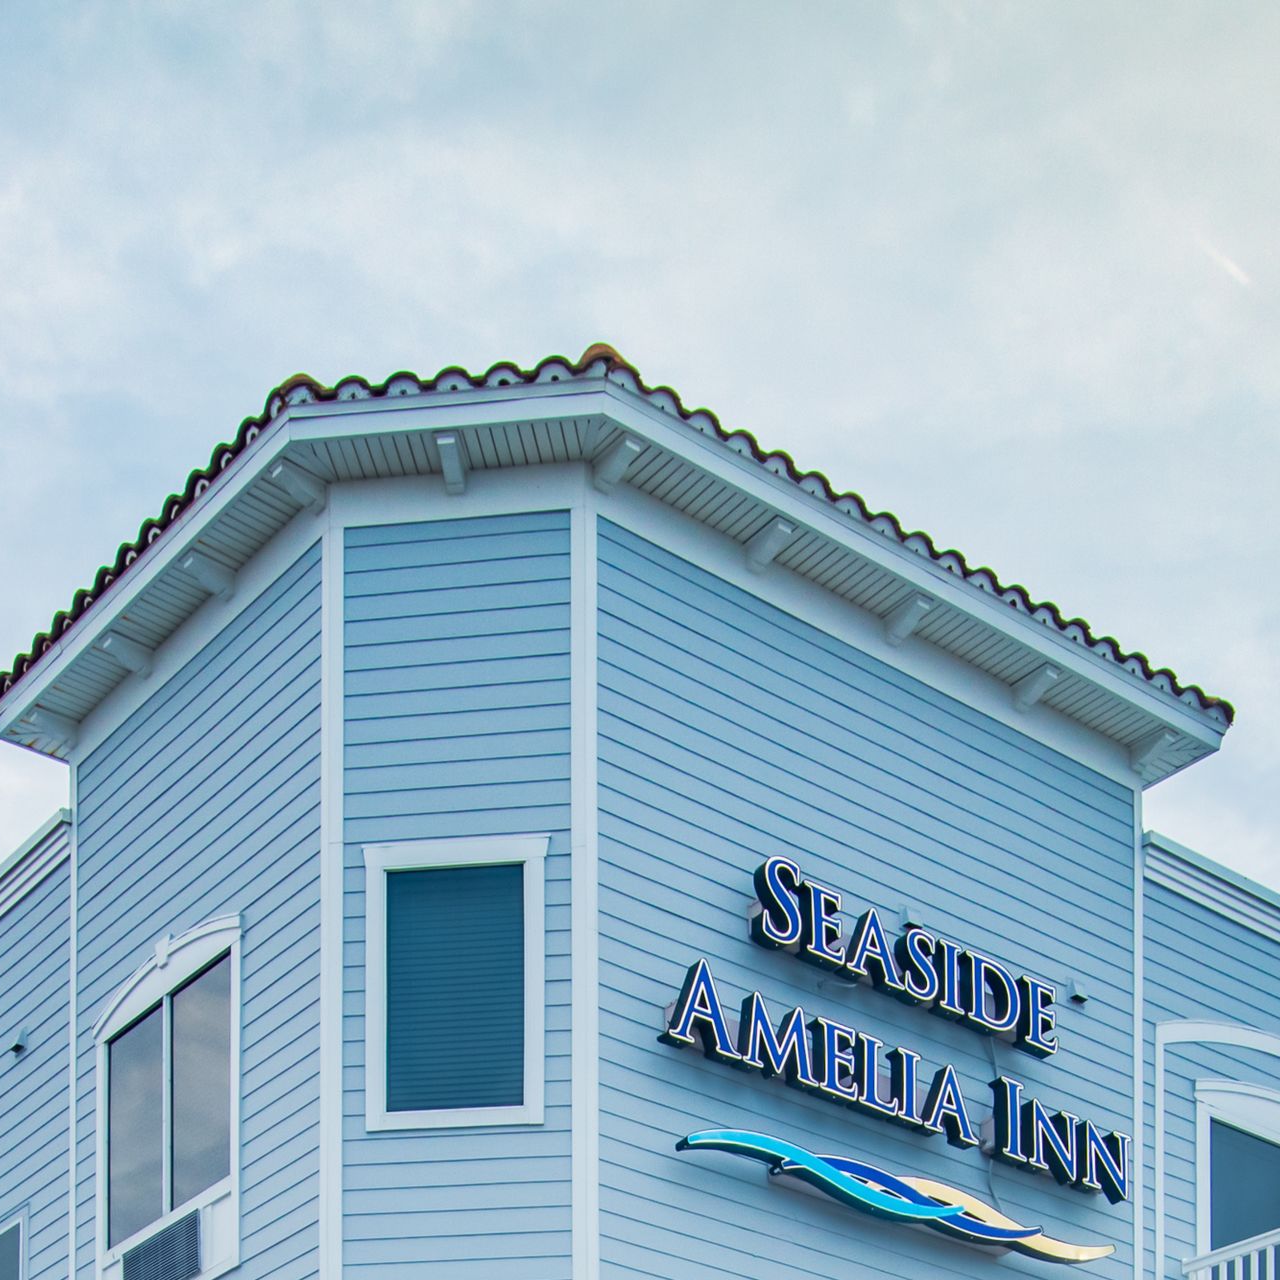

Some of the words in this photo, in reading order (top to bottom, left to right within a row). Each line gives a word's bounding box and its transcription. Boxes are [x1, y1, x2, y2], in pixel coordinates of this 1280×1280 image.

[756, 855, 1059, 1058] SEASIDE
[662, 957, 980, 1147] AMELIA
[991, 1075, 1132, 1203] INN
